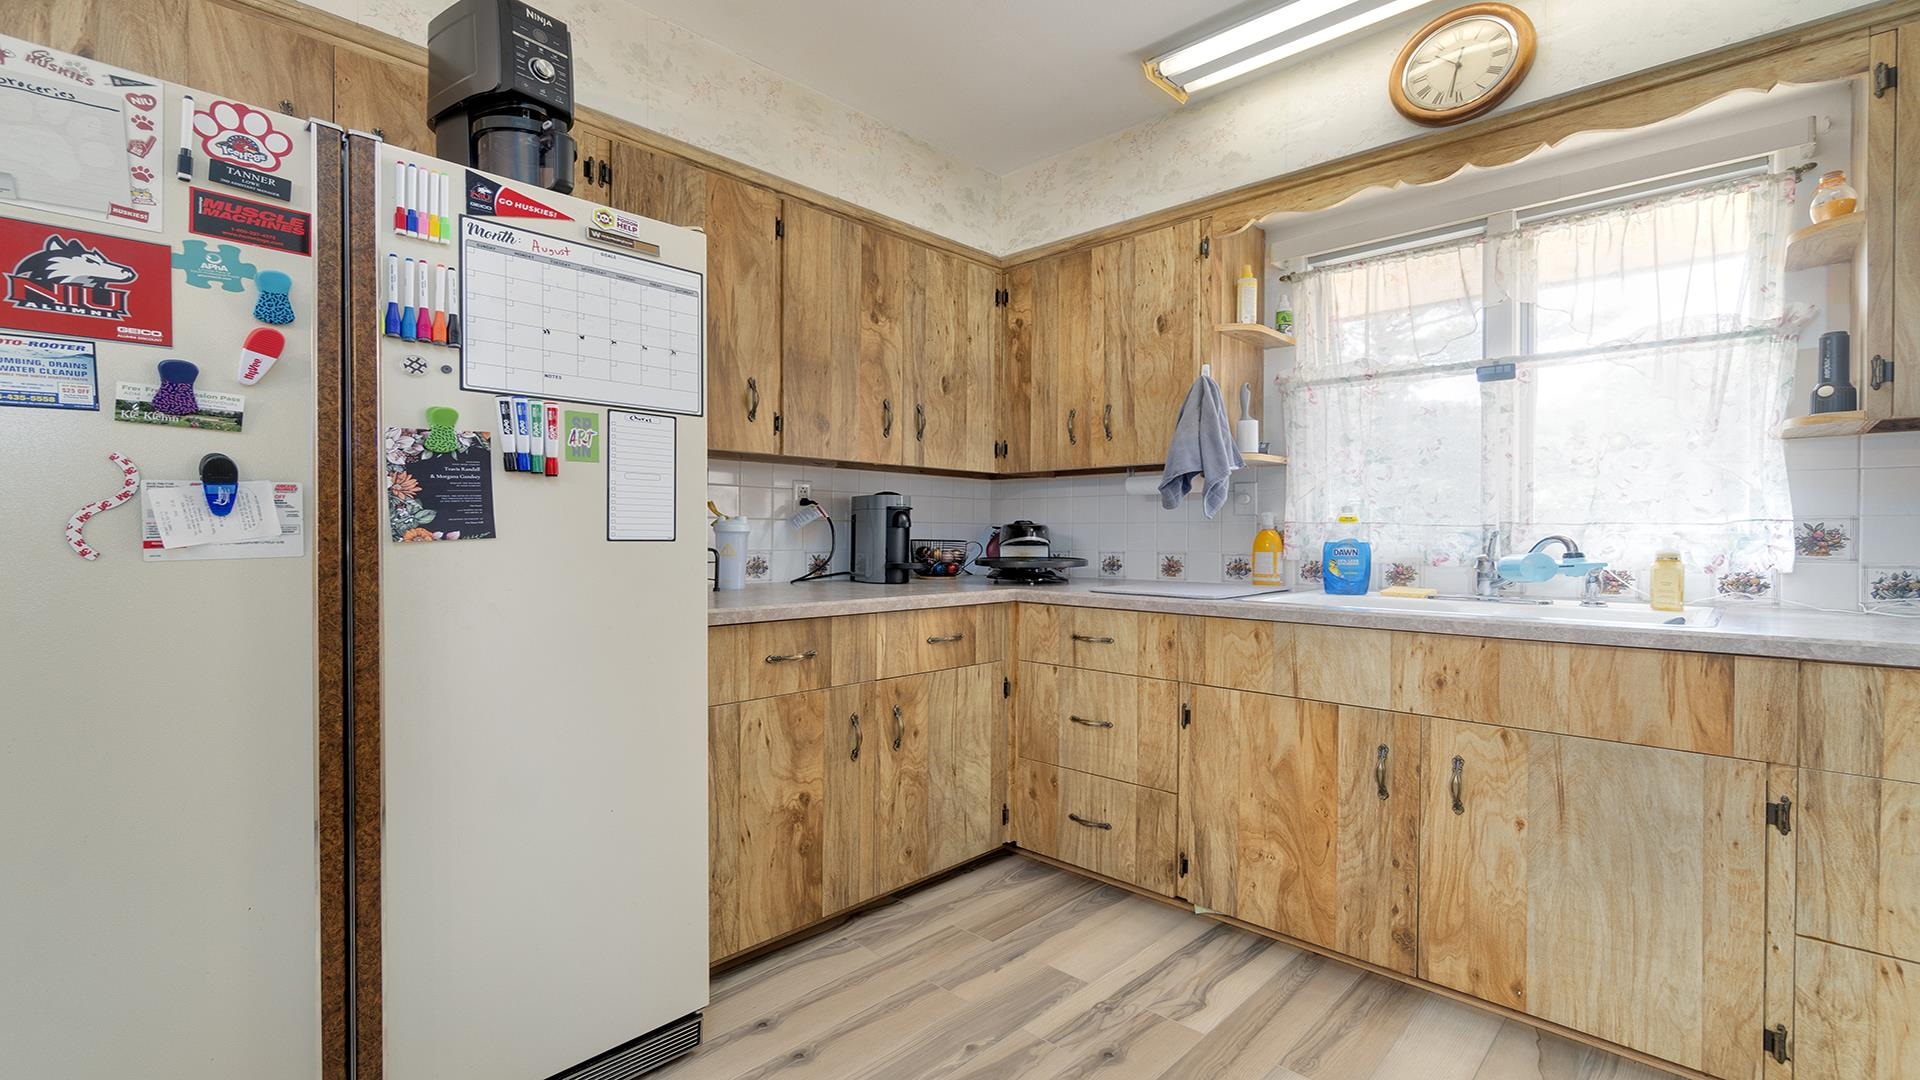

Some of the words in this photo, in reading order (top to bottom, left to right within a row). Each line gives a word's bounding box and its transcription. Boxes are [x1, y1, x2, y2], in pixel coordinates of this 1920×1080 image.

[526, 8, 553, 28] NINJA
[24, 54, 95, 87] HUSKIES
[130, 95, 154, 107] NIU
[226, 166, 277, 187] TANNER
[112, 205, 149, 220] HUSKIES!
[203, 198, 306, 227] MUSCLE
[469, 201, 493, 211] GEICO
[498, 197, 513, 207] GO
[514, 201, 558, 219] HUSKIES!
[202, 207, 306, 236] MACHINES
[616, 222, 639, 233] HELP
[531, 239, 572, 257] August
[8, 274, 125, 312] NIU
[25, 301, 114, 319] ALUMNI
[117, 326, 163, 338] GEICO
[0, 337, 87, 352] TO-ROOTER
[39, 367, 88, 378] CLEANUP
[48, 360, 88, 370] DRAINS
[544, 373, 562, 381] NOTES
[220, 394, 241, 403] Pass
[568, 429, 599, 447] ART
[1333, 549, 1359, 557] DAWN
